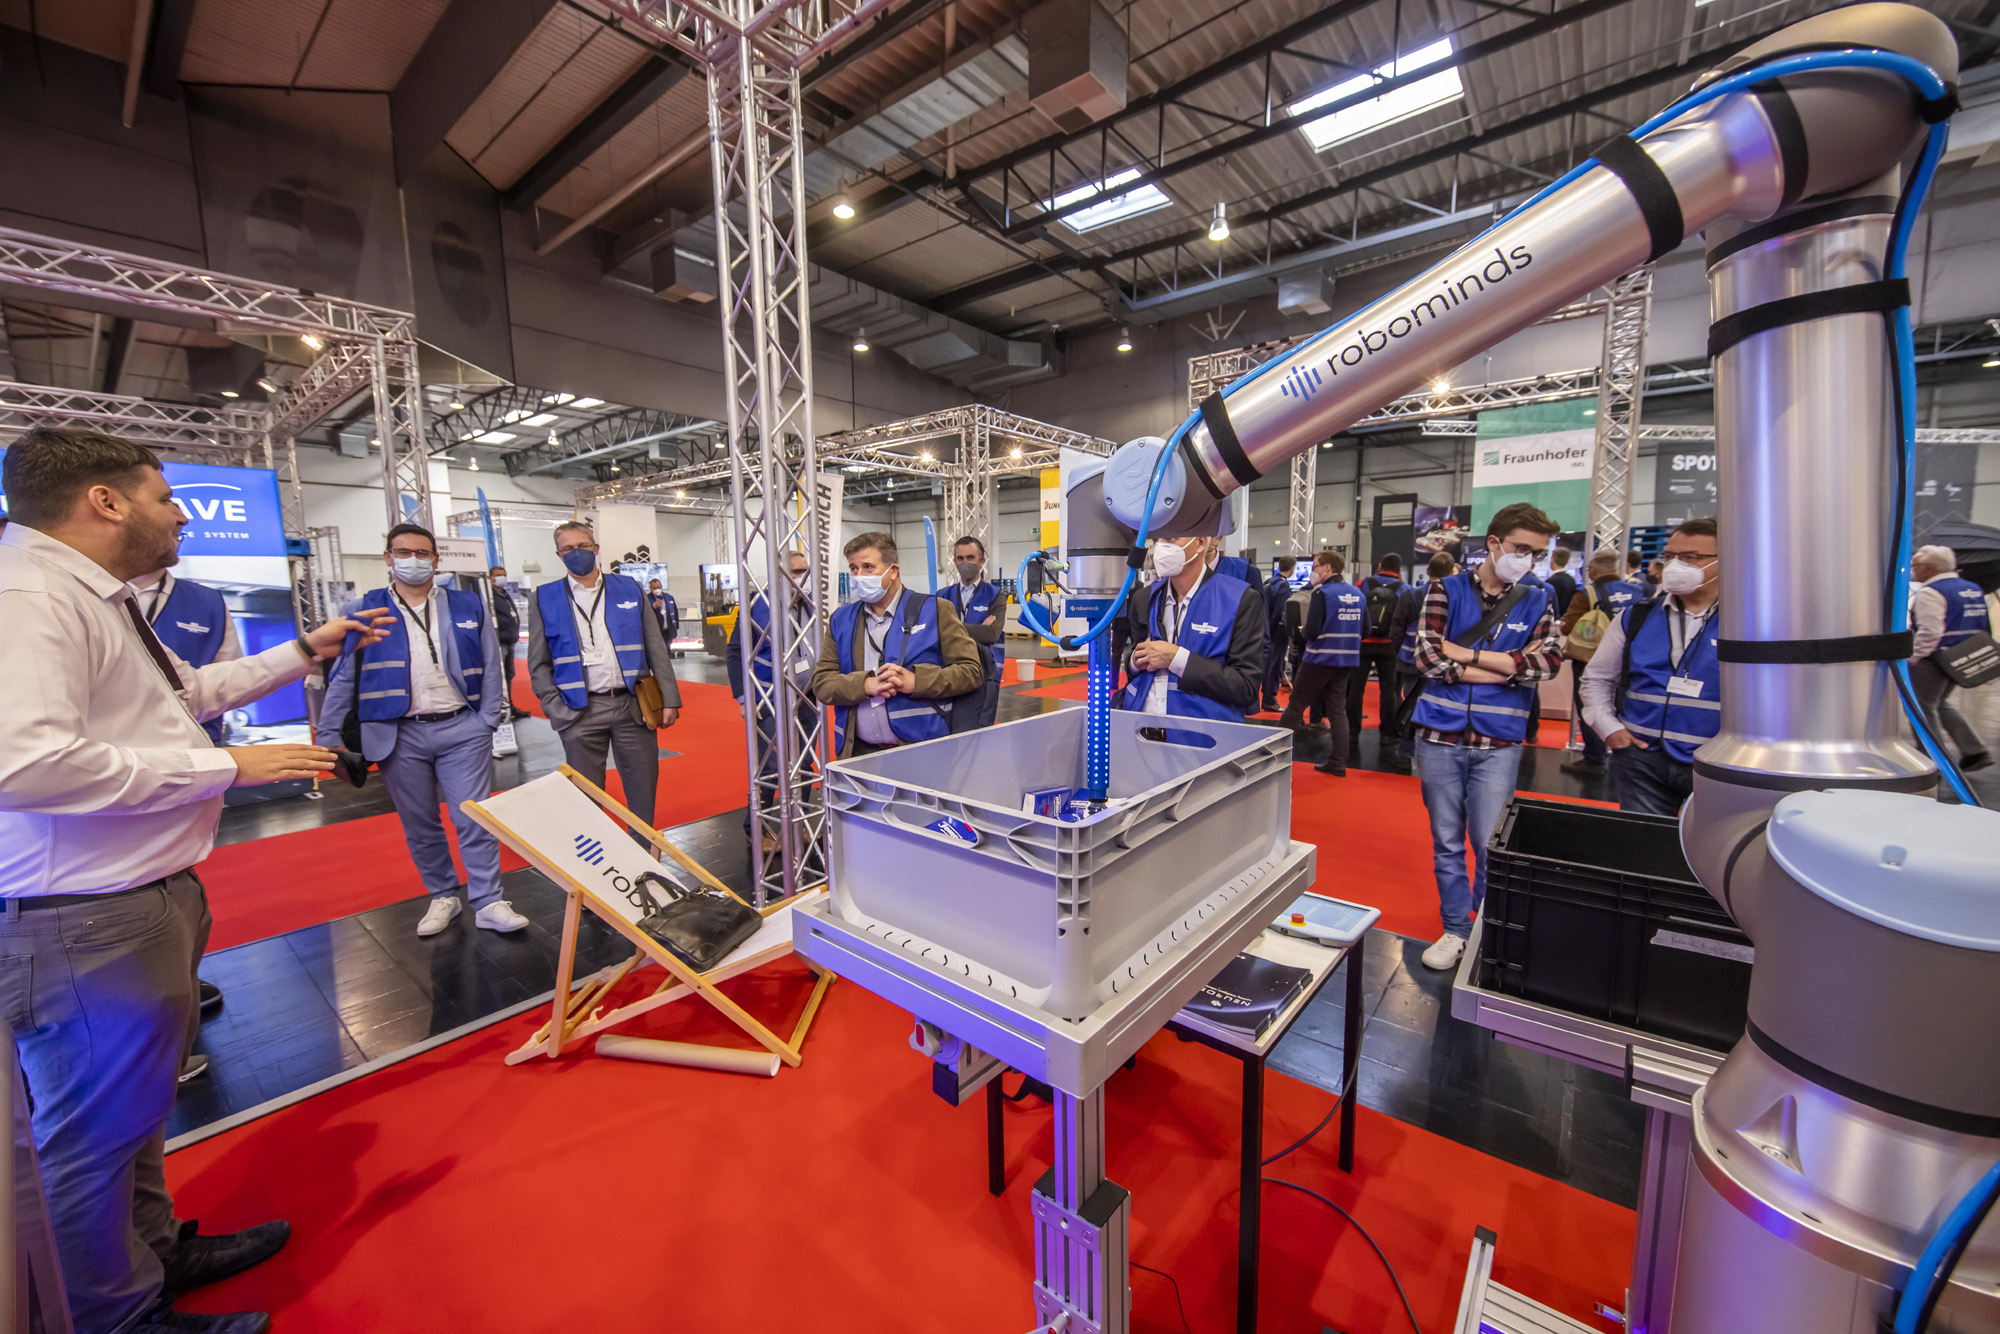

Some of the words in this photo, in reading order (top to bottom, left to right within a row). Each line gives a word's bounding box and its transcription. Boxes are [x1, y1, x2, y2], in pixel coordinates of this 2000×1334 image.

[1326, 245, 1533, 376] robominds
[1503, 448, 1588, 465] Fraunhofer
[203, 531, 250, 539] SYSTEM
